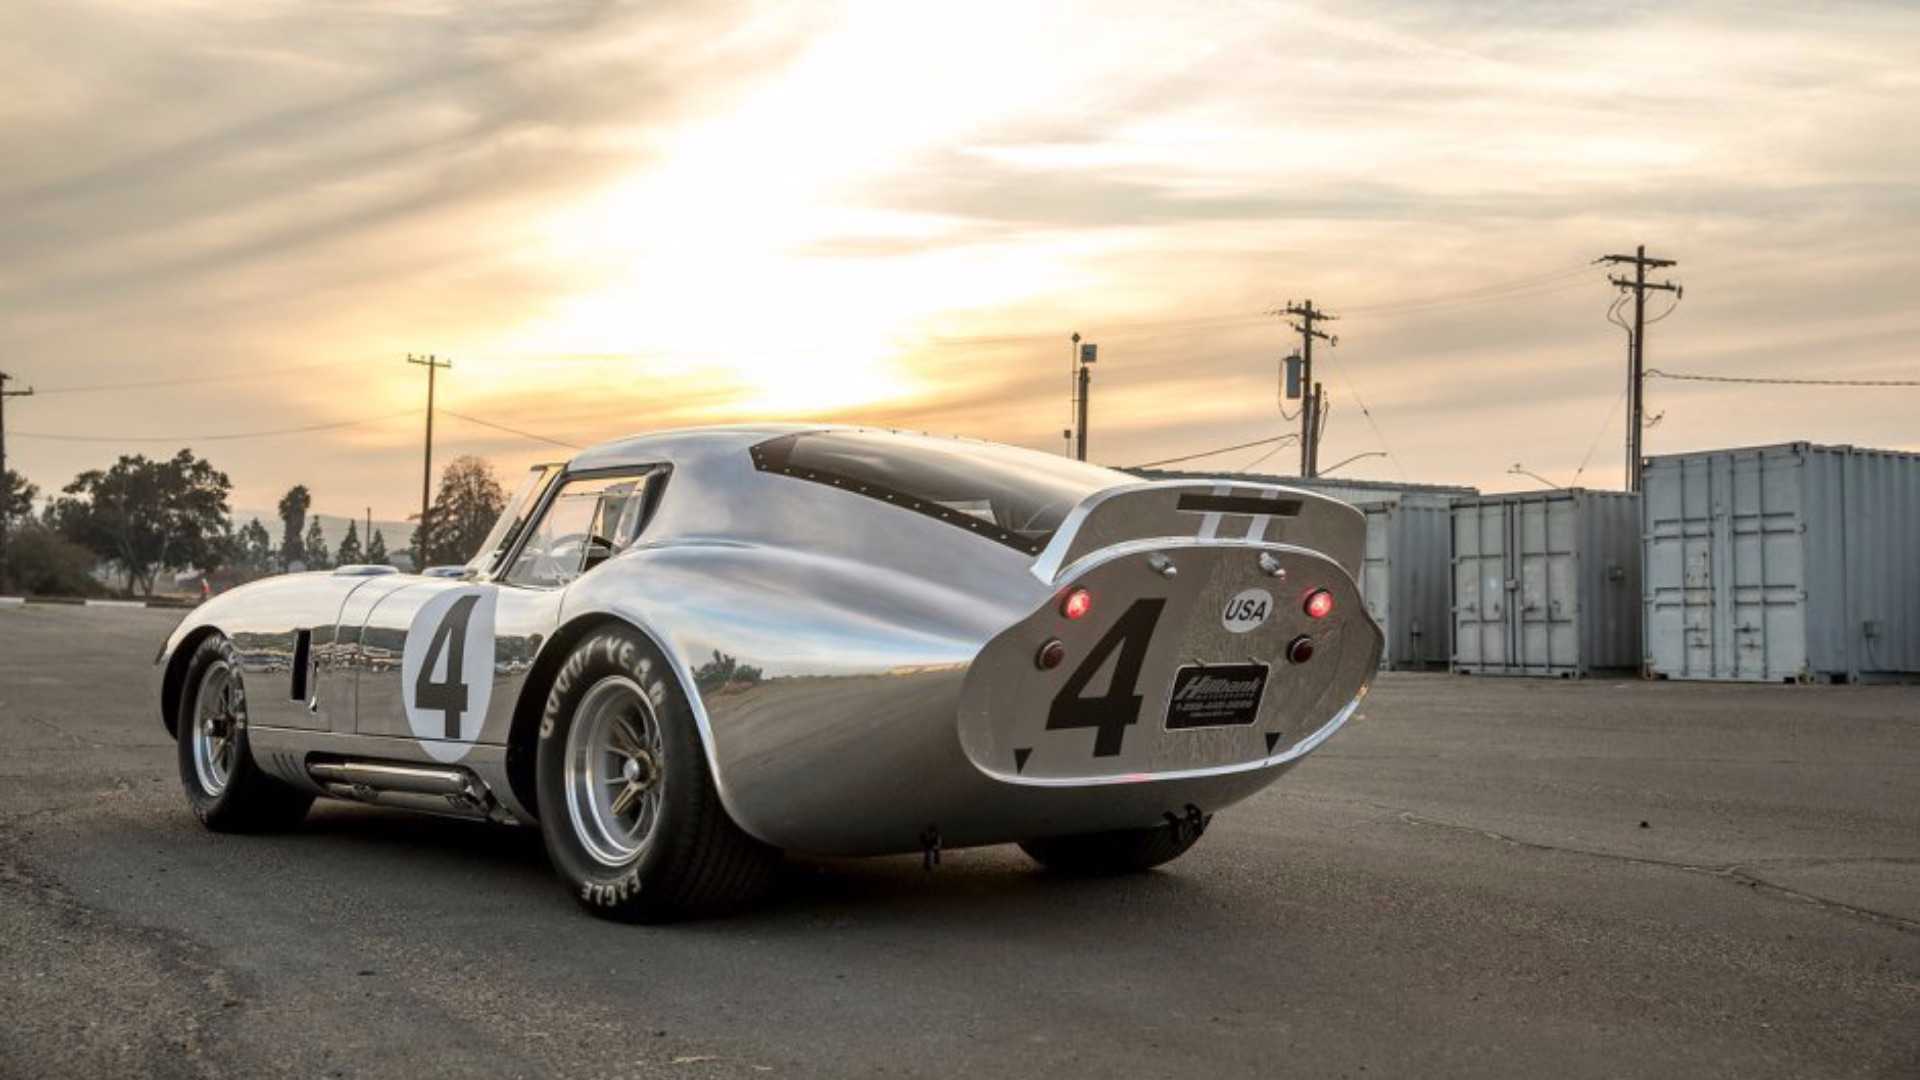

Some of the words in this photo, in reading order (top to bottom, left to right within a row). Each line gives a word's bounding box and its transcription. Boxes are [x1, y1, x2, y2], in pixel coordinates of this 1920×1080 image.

[1225, 599, 1266, 621] USA
[415, 595, 481, 739] 4
[1046, 598, 1167, 758] 4
[581, 868, 642, 907] EAGLE
